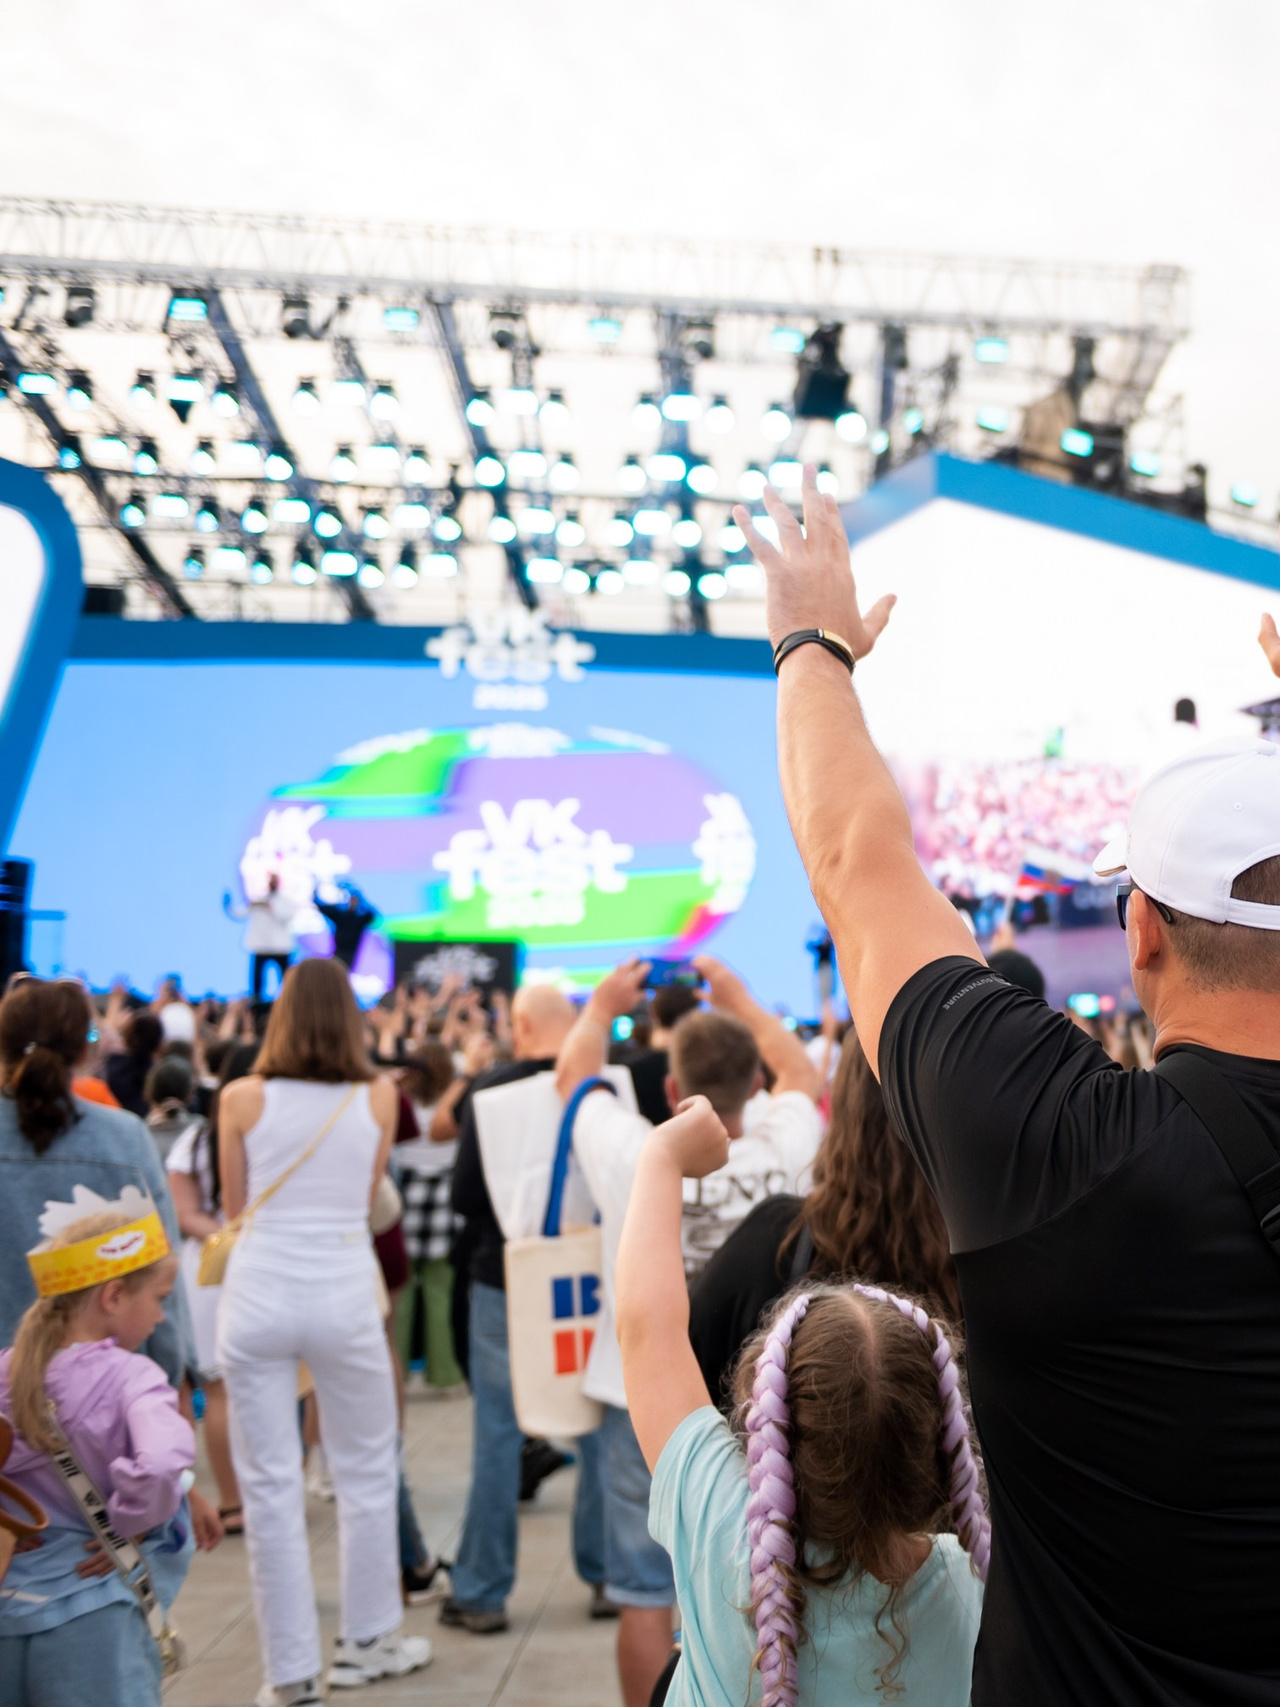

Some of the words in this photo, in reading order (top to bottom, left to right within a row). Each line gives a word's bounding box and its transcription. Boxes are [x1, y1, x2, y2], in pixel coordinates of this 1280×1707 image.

[479, 797, 590, 848] VK
[432, 828, 634, 900] fest
[942, 976, 994, 1010] OUTVENTURE
